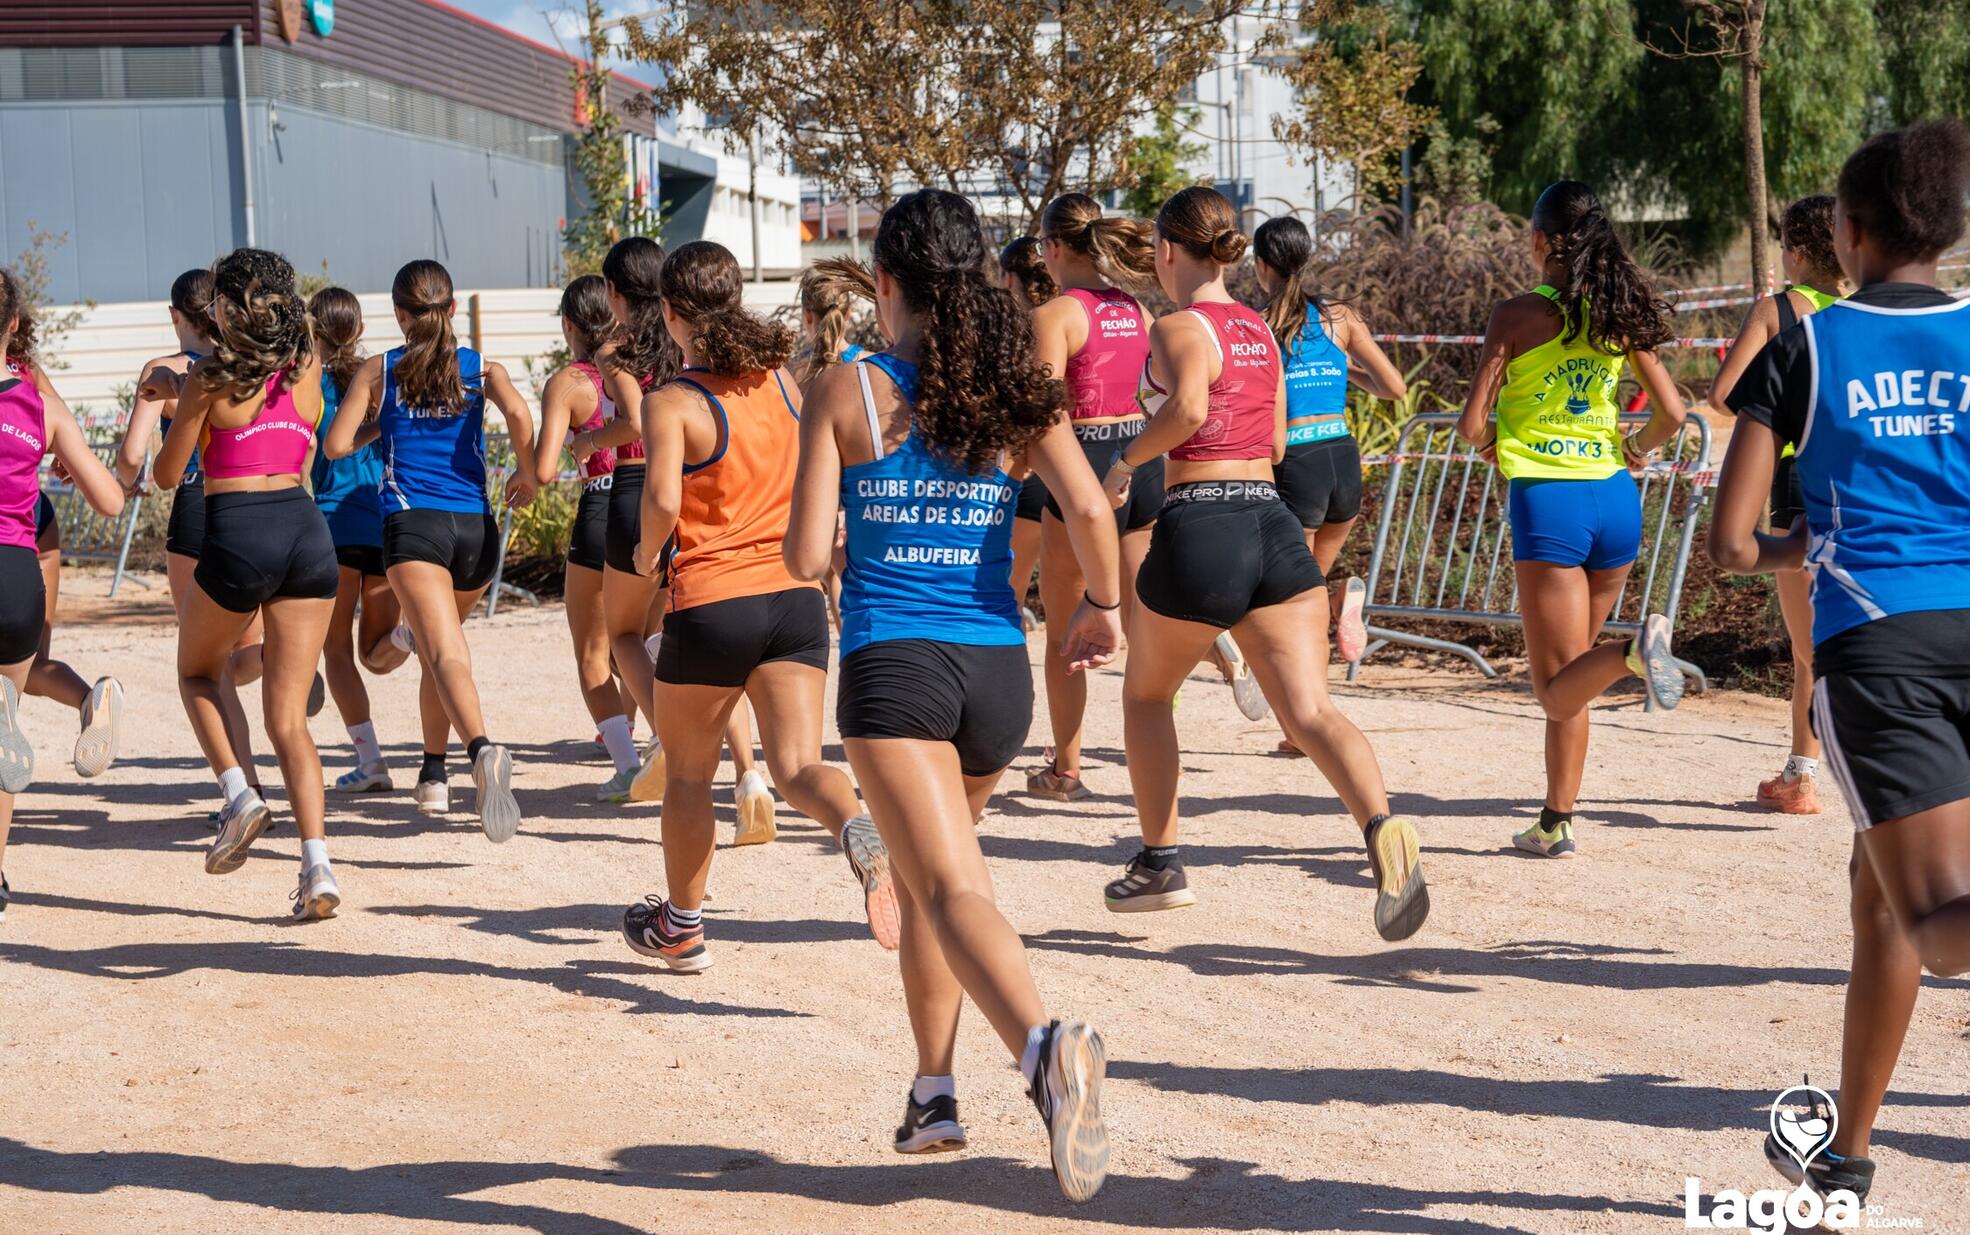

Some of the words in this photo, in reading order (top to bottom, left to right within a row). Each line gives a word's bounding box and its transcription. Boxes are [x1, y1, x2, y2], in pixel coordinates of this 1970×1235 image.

[1101, 317, 1137, 330] PECHÃO
[1534, 392, 1546, 402] A
[235, 423, 267, 441] OLIMPICO
[267, 421, 288, 429] CLUBE
[288, 422, 297, 430] DE
[1118, 418, 1146, 438] NIK
[1287, 426, 1315, 442] IKE
[1868, 413, 1955, 438] TUNES
[1, 424, 15, 435] DE
[14, 428, 42, 452] LAGOS
[858, 480, 908, 497] CLUBE
[914, 480, 1013, 503] DESPORTIVO
[1192, 488, 1222, 498] PRO
[862, 504, 920, 524] AREIAS
[925, 507, 947, 524] DE
[952, 505, 1005, 526] S.JOÃO
[883, 546, 982, 565] ALBUFEIRA
